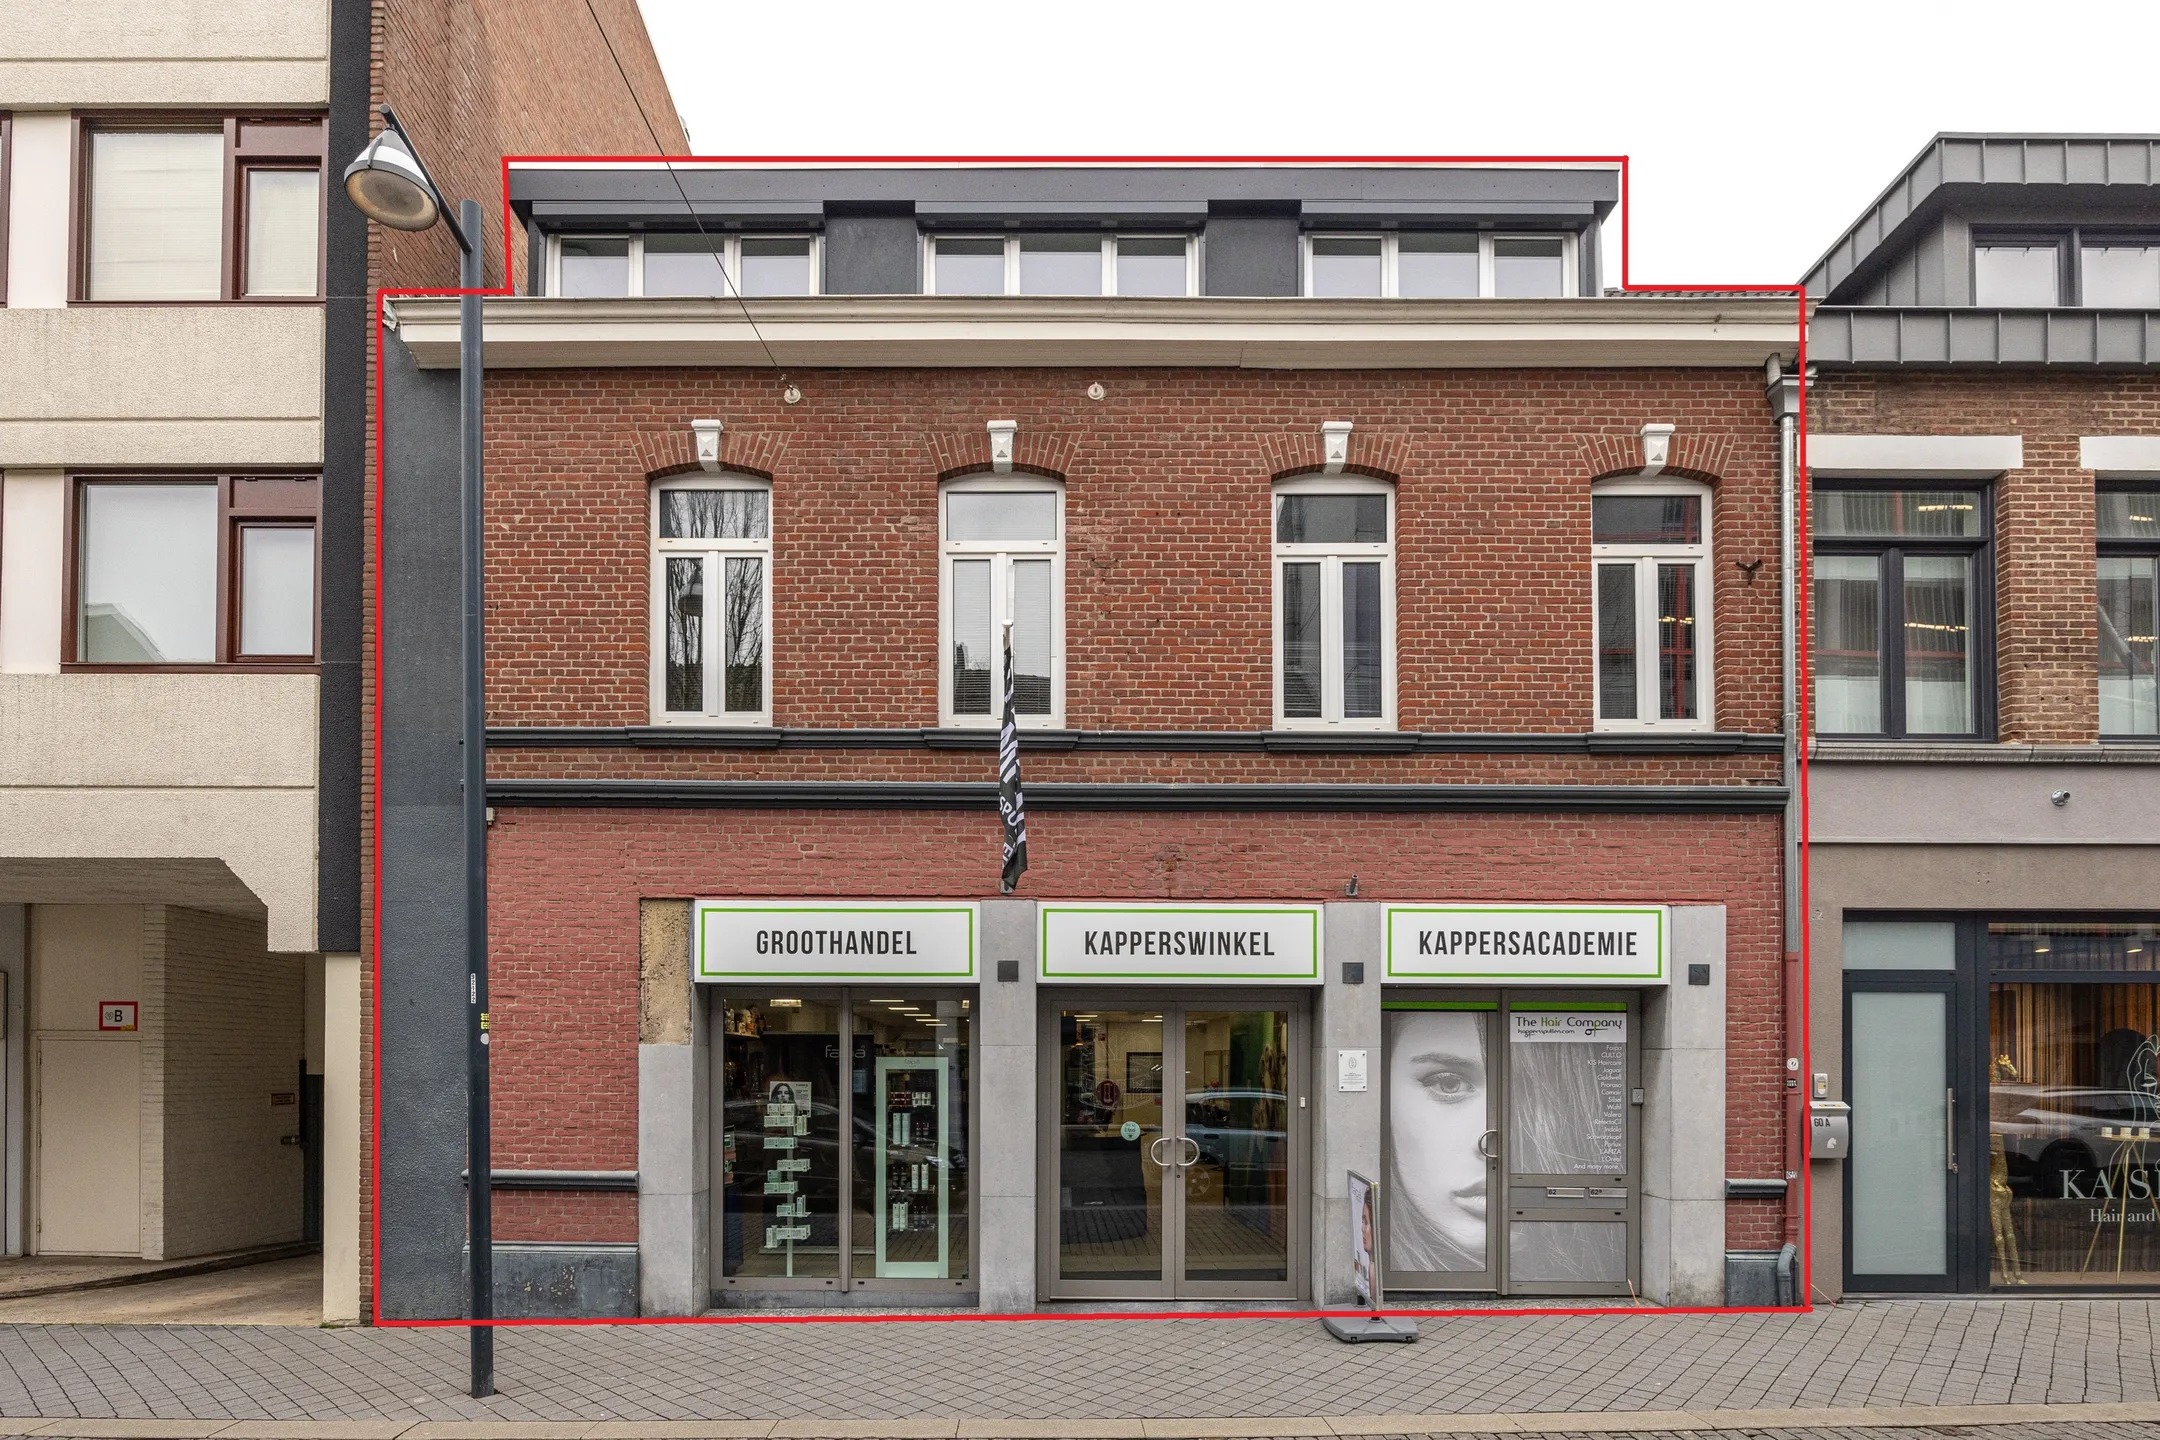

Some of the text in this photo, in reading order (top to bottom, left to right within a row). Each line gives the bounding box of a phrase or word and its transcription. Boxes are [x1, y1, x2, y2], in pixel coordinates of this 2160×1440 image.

[756, 930, 917, 955] GROOTHANDEL
[1085, 931, 1275, 956] KAPPERSWINKEL
[1419, 930, 1637, 956] KAPPERSACADEMIE
[114, 1009, 123, 1022] B
[1515, 1016, 1622, 1031] The Hair Company
[1814, 1118, 1831, 1127] 60 A
[1586, 1133, 1622, 1141] Schwarzkopf
[2089, 1208, 2155, 1222] Hair and
